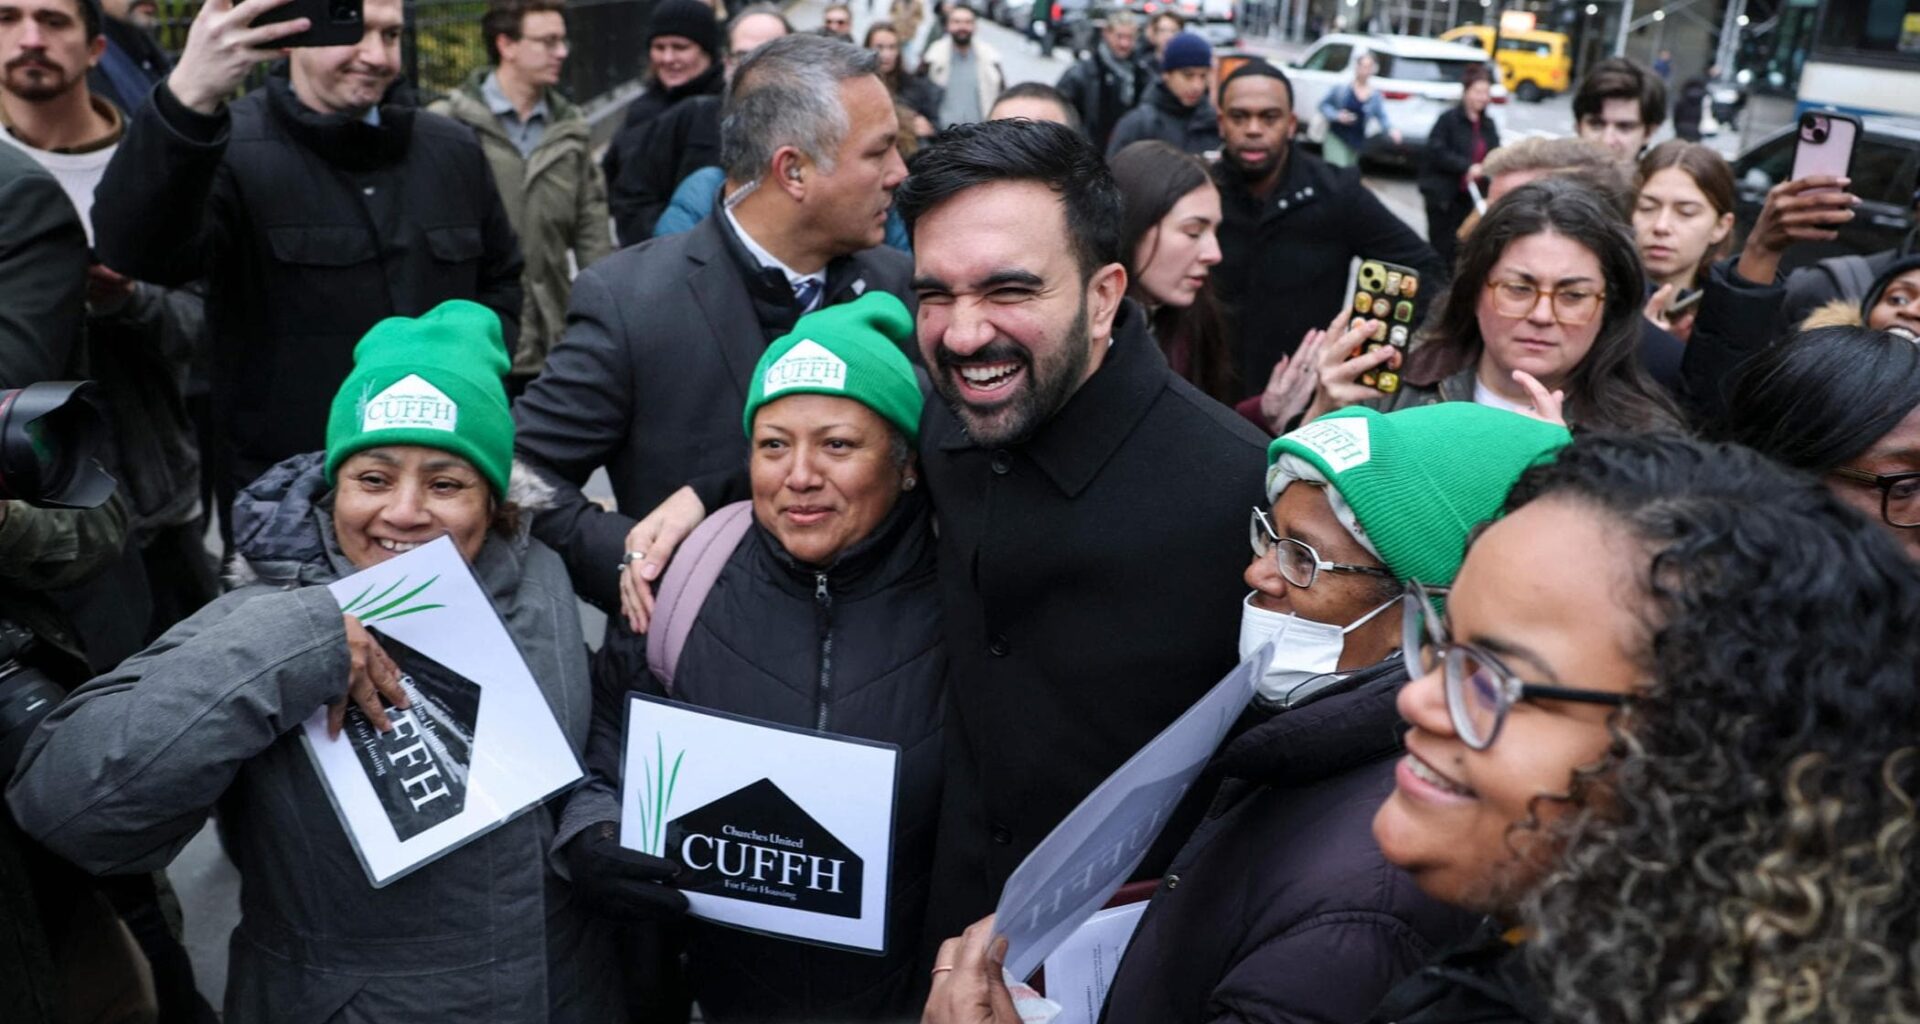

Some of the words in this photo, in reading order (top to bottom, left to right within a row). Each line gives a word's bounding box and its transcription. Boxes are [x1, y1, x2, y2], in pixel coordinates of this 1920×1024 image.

[768, 362, 840, 384] CUFFH
[368, 399, 453, 421] CUFFH
[356, 721, 369, 740] Fair
[364, 738, 387, 777] Housing
[376, 705, 452, 812] FFH
[722, 824, 769, 842] Churches
[770, 833, 804, 849] United
[681, 833, 845, 893] CUFFH
[724, 879, 740, 890] For
[741, 882, 759, 894] Fair
[760, 886, 797, 902] Housing
